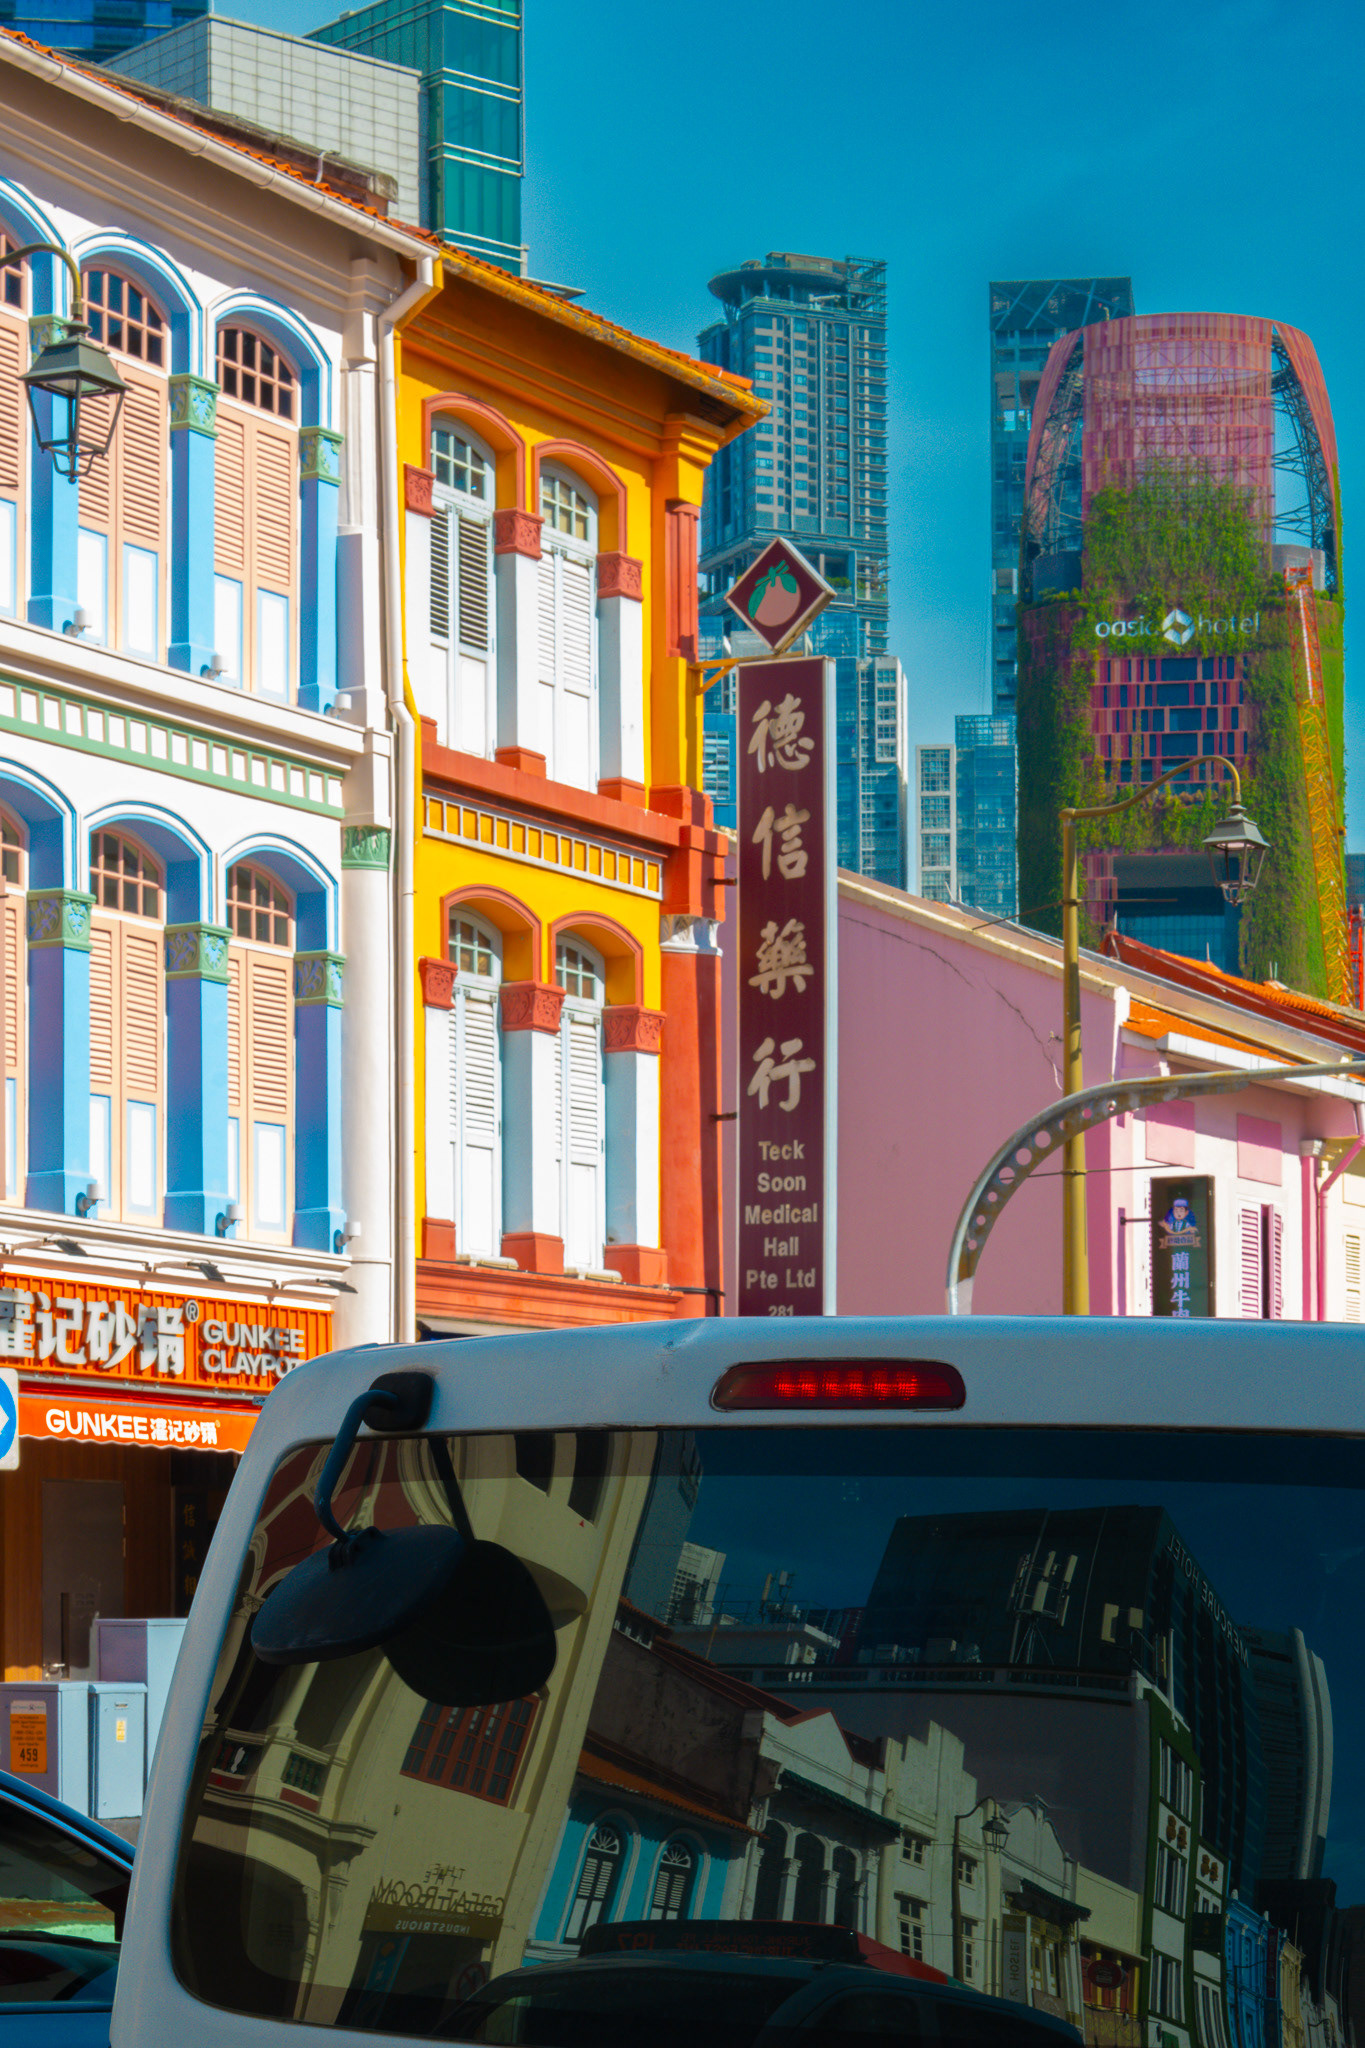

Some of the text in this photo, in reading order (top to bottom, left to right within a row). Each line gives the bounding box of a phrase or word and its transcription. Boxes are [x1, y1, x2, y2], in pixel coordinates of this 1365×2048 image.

[1198, 611, 1260, 635] hotel
[758, 1140, 805, 1161] Teck
[757, 1172, 806, 1193] Soon
[745, 1203, 818, 1225] Medical
[764, 1236, 799, 1257] Hall
[746, 1268, 816, 1290] Pte Ltd
[768, 1304, 794, 1317] 281
[203, 1319, 306, 1353] GUNKEE
[46, 1408, 149, 1440] GUNKEE
[20, 1748, 38, 1762] 459
